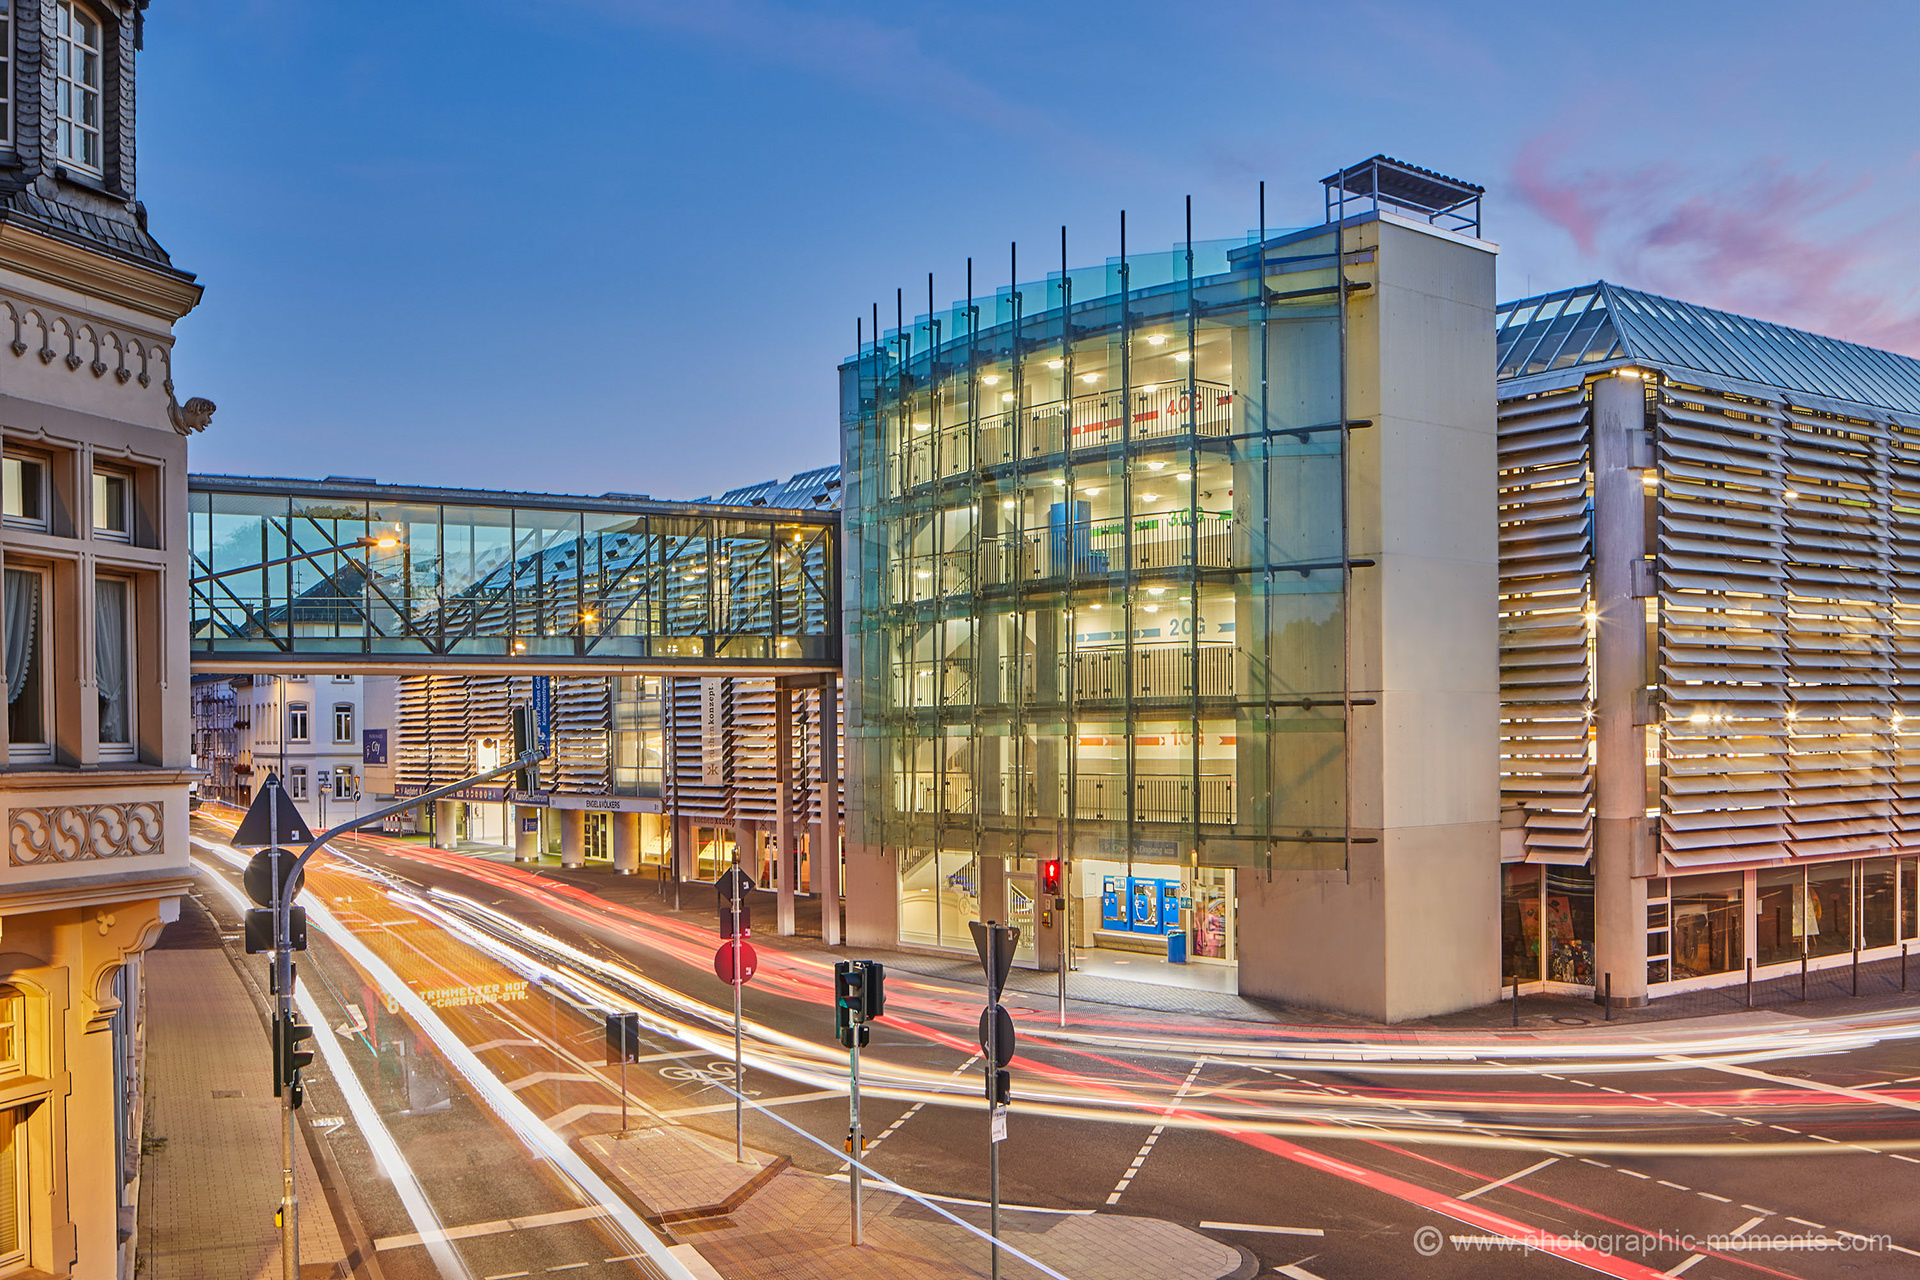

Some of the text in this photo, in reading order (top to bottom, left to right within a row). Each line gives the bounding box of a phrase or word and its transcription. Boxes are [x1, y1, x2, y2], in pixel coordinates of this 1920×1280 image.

[419, 981, 528, 1000] TRIMMELTER HOF
[423, 991, 529, 1009] .-CARSTENS-STR.
